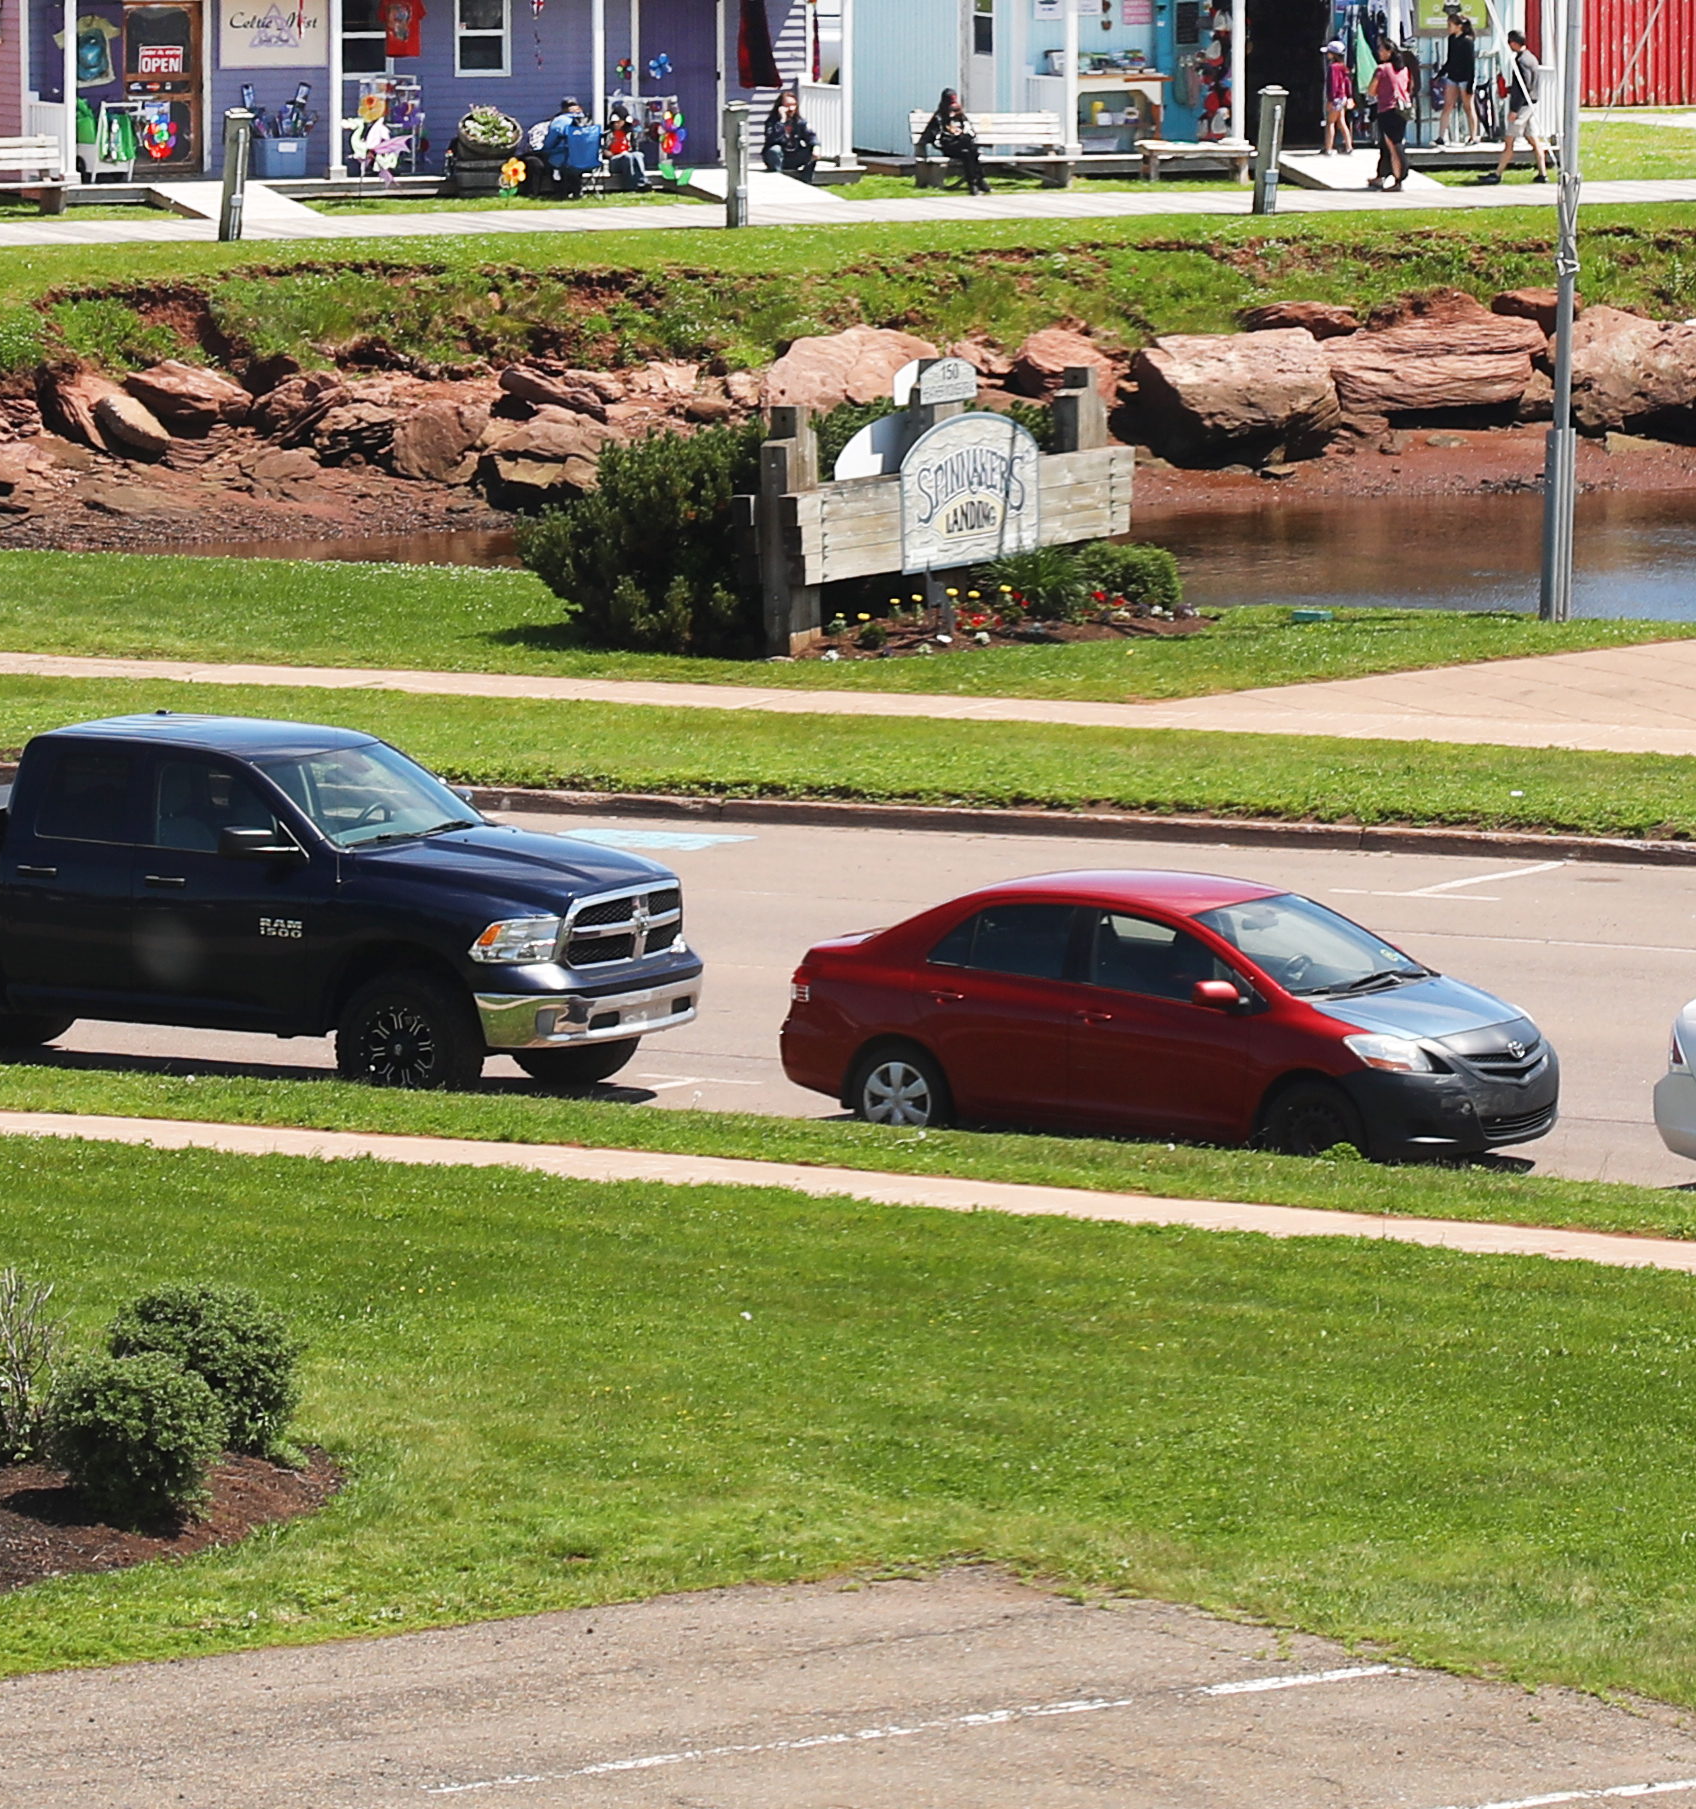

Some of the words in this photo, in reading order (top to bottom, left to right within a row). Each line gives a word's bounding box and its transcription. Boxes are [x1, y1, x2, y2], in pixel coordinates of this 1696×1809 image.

[230, 12, 272, 29] Celtic
[141, 57, 180, 73] OPEN
[941, 362, 959, 380] 150
[945, 500, 997, 534] LANDING
[259, 917, 303, 929] RAM
[259, 926, 303, 938] 1500
